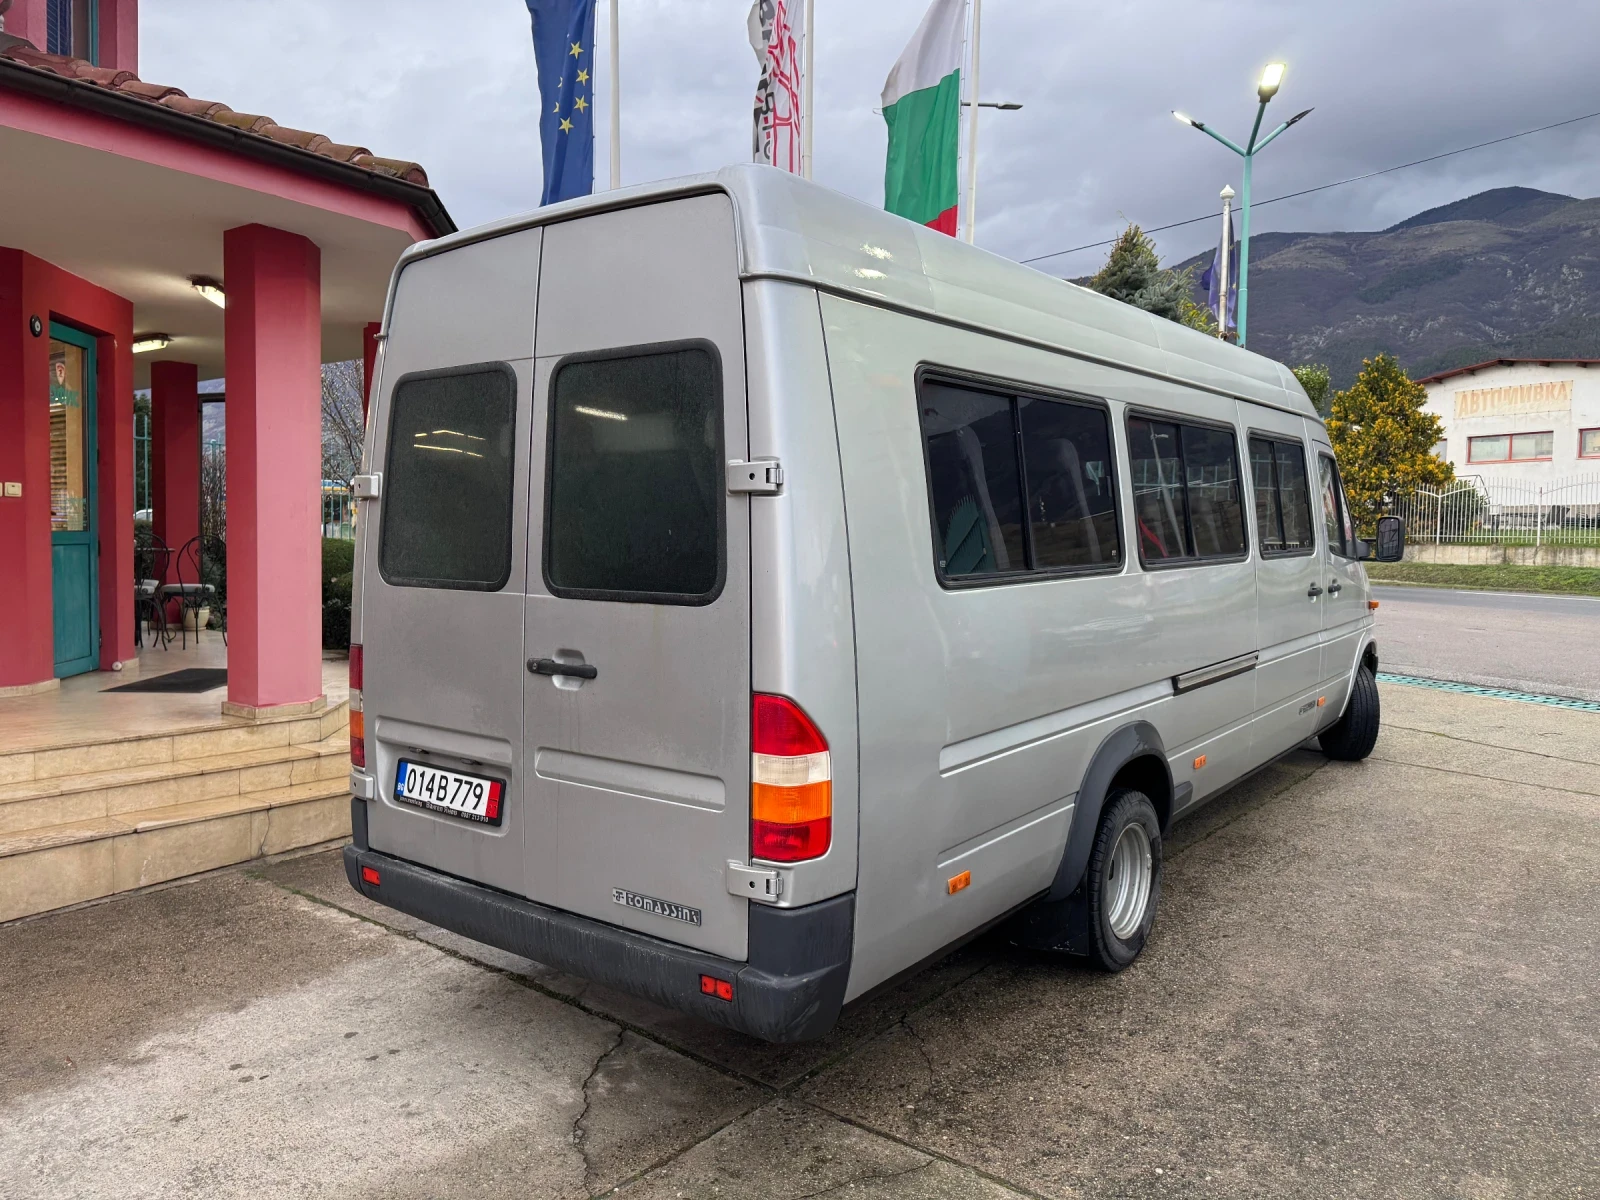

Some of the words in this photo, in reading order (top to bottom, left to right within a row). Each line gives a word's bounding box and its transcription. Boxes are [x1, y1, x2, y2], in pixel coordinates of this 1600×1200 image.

[1458, 383, 1568, 418] АВТОМИВКА
[397, 782, 405, 791] BG
[407, 768, 484, 811] 014B779
